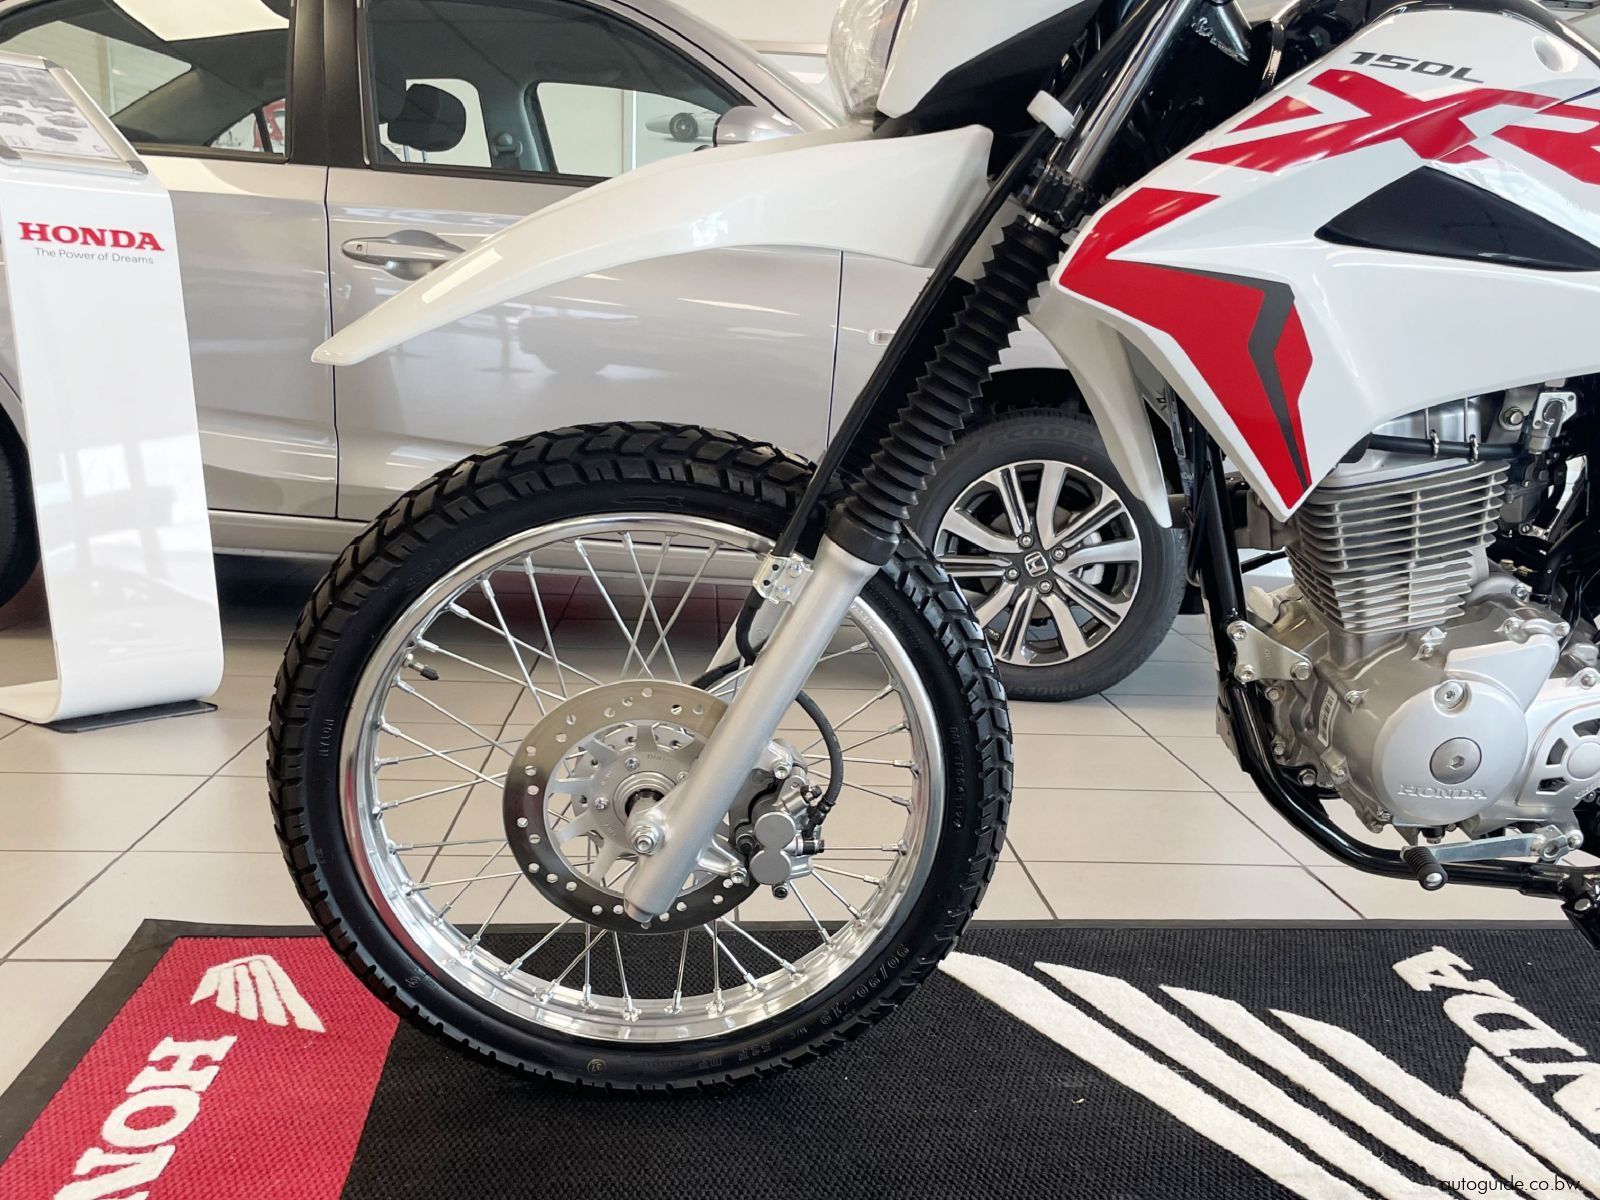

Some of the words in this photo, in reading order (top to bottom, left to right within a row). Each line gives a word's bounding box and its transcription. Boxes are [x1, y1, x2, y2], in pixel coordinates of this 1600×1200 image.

[1350, 51, 1484, 84] 150L
[18, 222, 165, 251] HONDA
[34, 246, 57, 258] The
[59, 249, 94, 261] Power
[97, 252, 109, 262] of
[111, 253, 154, 265] Dreams
[1397, 784, 1487, 800] HONDA
